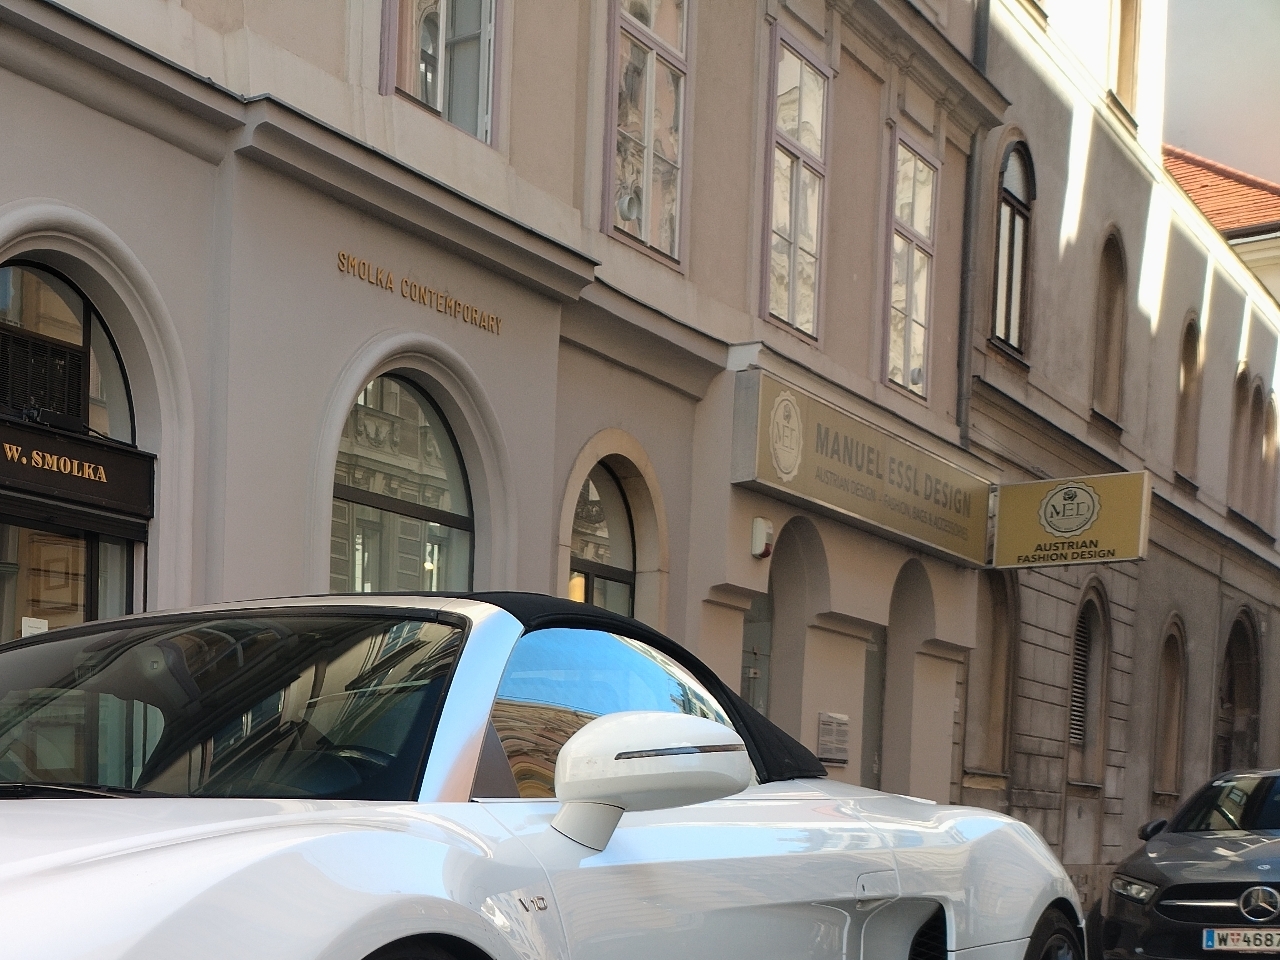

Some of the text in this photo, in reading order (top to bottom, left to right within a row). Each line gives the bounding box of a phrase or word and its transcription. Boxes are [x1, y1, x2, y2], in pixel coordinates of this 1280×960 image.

[337, 251, 503, 335] SMOLKA CONTEMPORARY
[2, 442, 108, 483] W. SMOLKA
[815, 423, 883, 479] MANUEL
[888, 456, 919, 497] ESSL
[924, 472, 971, 518] DESIGN
[815, 465, 850, 492] AUSTRIAN
[850, 480, 876, 502] DESIGN
[1017, 549, 1115, 563] FASHION DESIGN
[1034, 539, 1099, 552] AUSTRIAN
[1217, 932, 1229, 946] W
